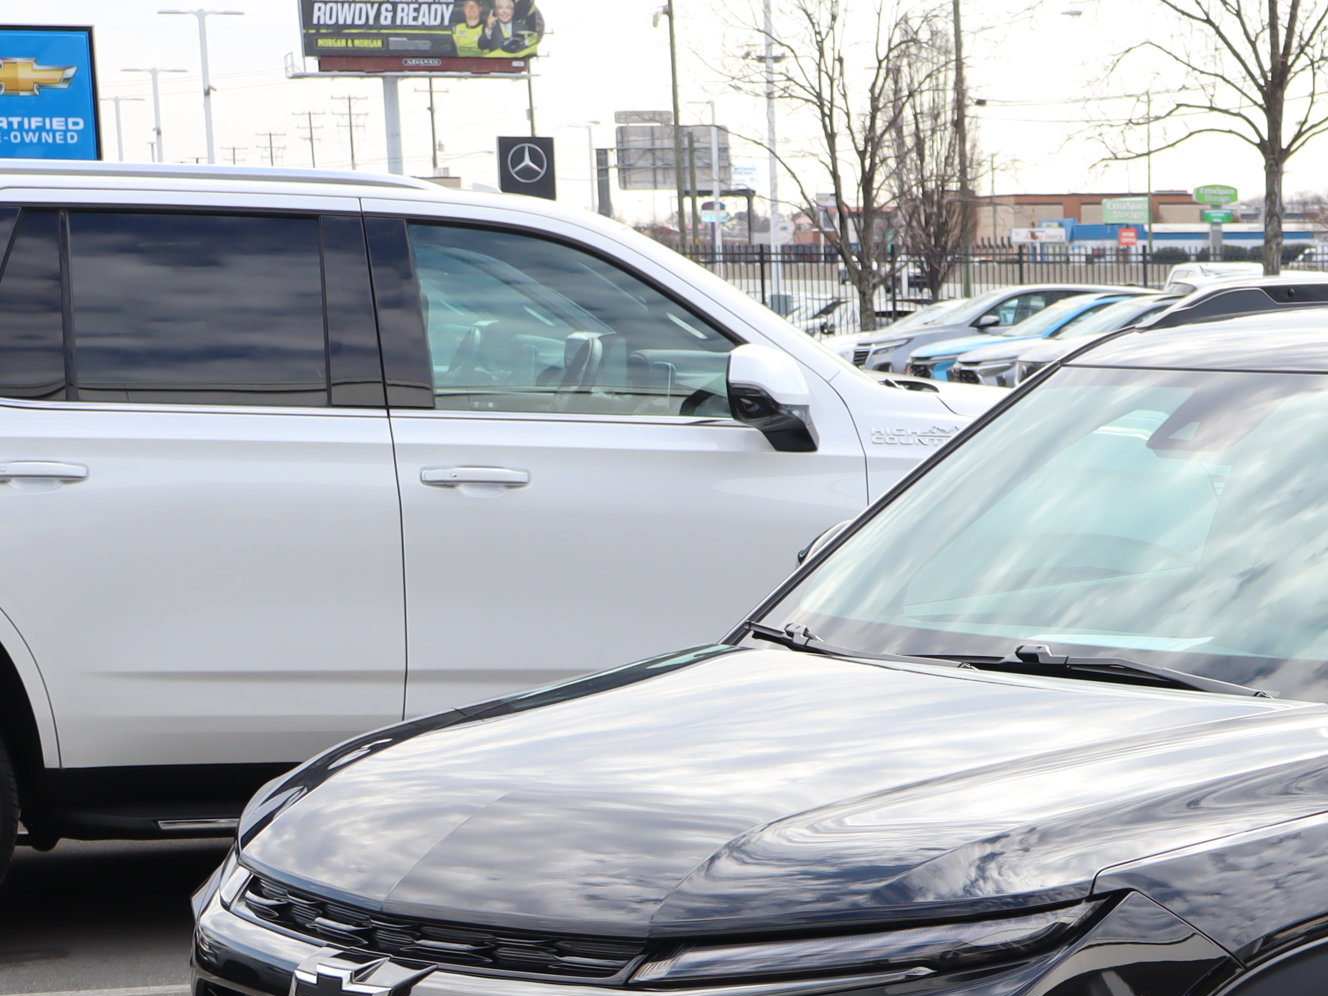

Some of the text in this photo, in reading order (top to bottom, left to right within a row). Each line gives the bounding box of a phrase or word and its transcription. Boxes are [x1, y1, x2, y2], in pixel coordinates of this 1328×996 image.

[312, 3, 455, 26] ROWDY & READY
[317, 39, 346, 47] MORGAN
[354, 39, 383, 47] MORGAN
[871, 436, 944, 446] COUNT
